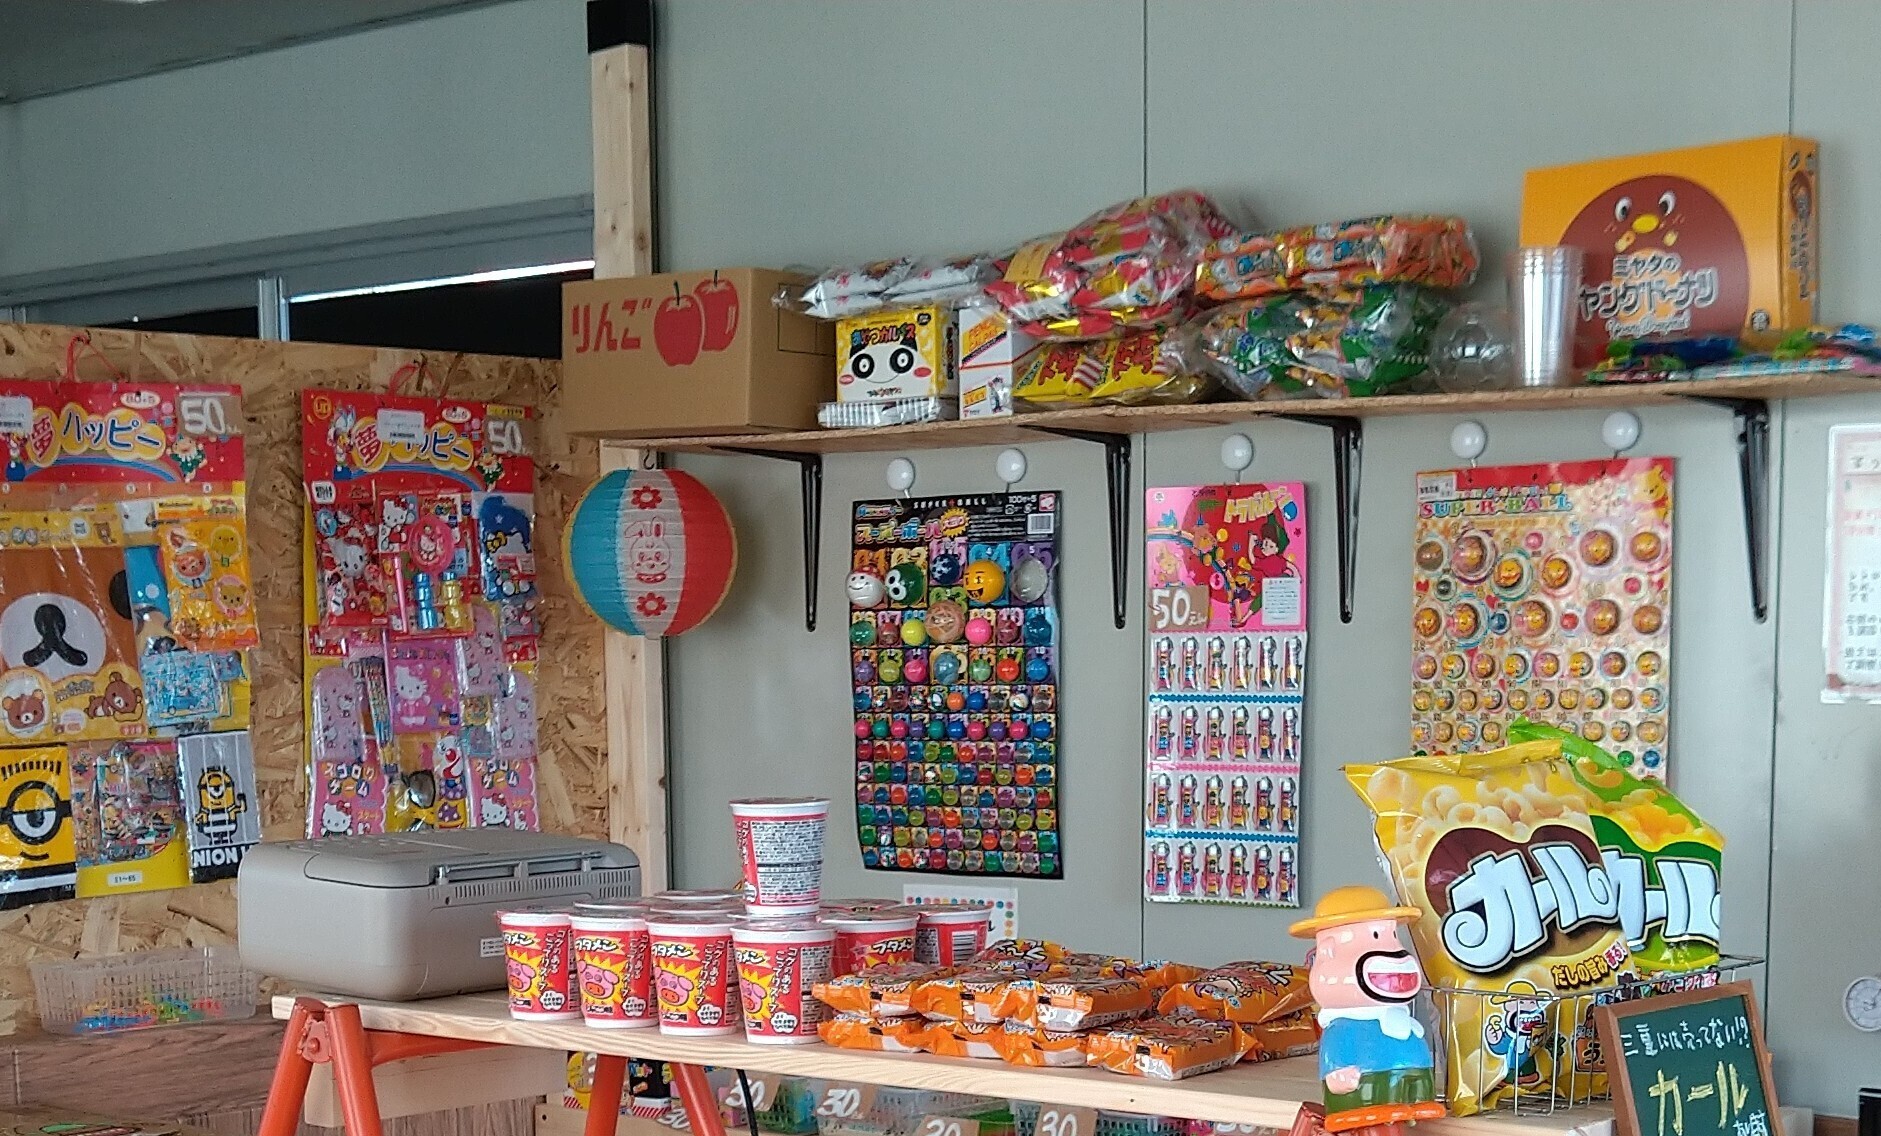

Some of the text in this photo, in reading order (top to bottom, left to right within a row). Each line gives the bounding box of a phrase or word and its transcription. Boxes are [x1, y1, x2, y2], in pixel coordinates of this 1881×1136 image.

[571, 297, 654, 353] りんご
[1419, 500, 1496, 518] SUPER
[1442, 838, 1622, 978] カール
